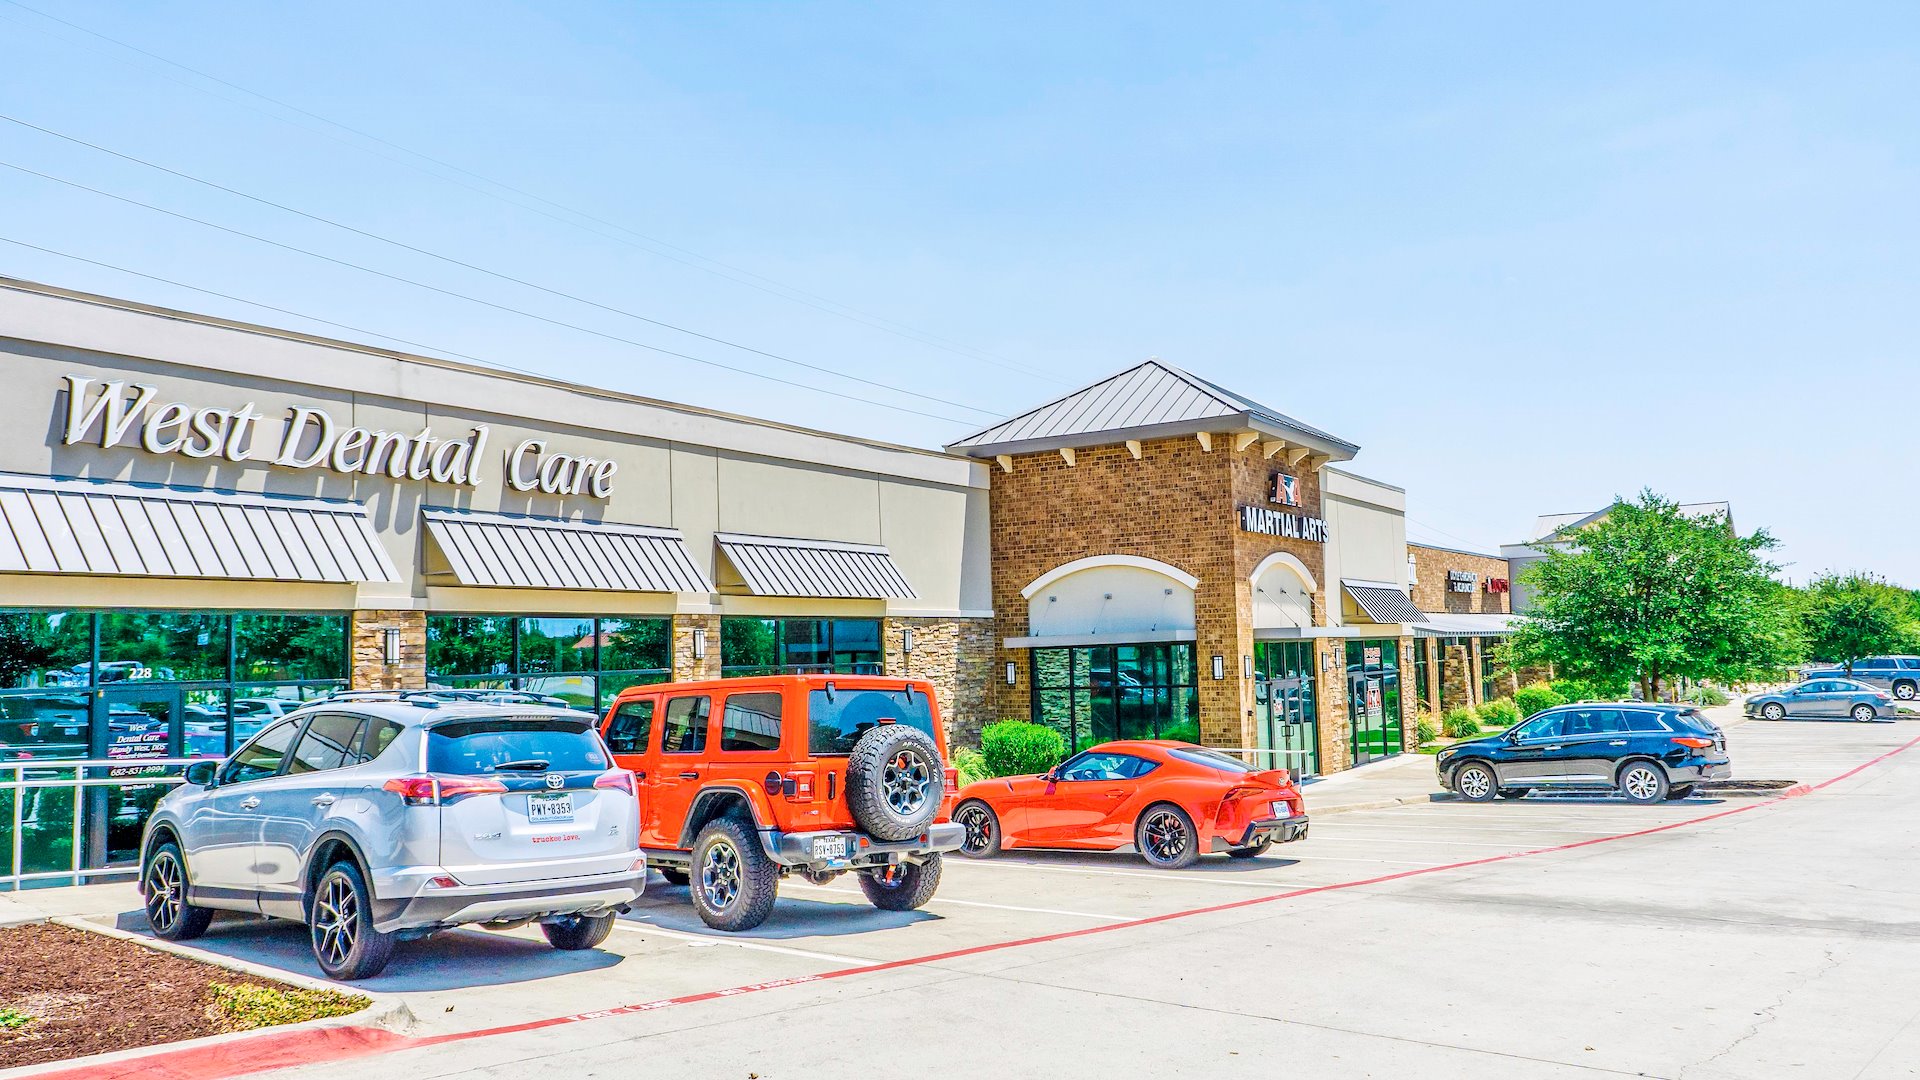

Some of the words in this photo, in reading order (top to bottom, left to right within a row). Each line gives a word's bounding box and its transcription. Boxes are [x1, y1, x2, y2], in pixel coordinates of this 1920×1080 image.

[61, 374, 263, 461] West
[271, 403, 490, 488] Dental
[507, 438, 619, 499] Care
[1245, 506, 1300, 539] MARTIAL
[1302, 516, 1330, 544] ARTS
[129, 667, 153, 679] 228
[129, 724, 148, 732] West
[116, 734, 142, 743] Dental
[143, 734, 160, 742] Care
[111, 765, 165, 776] 682-831-9994
